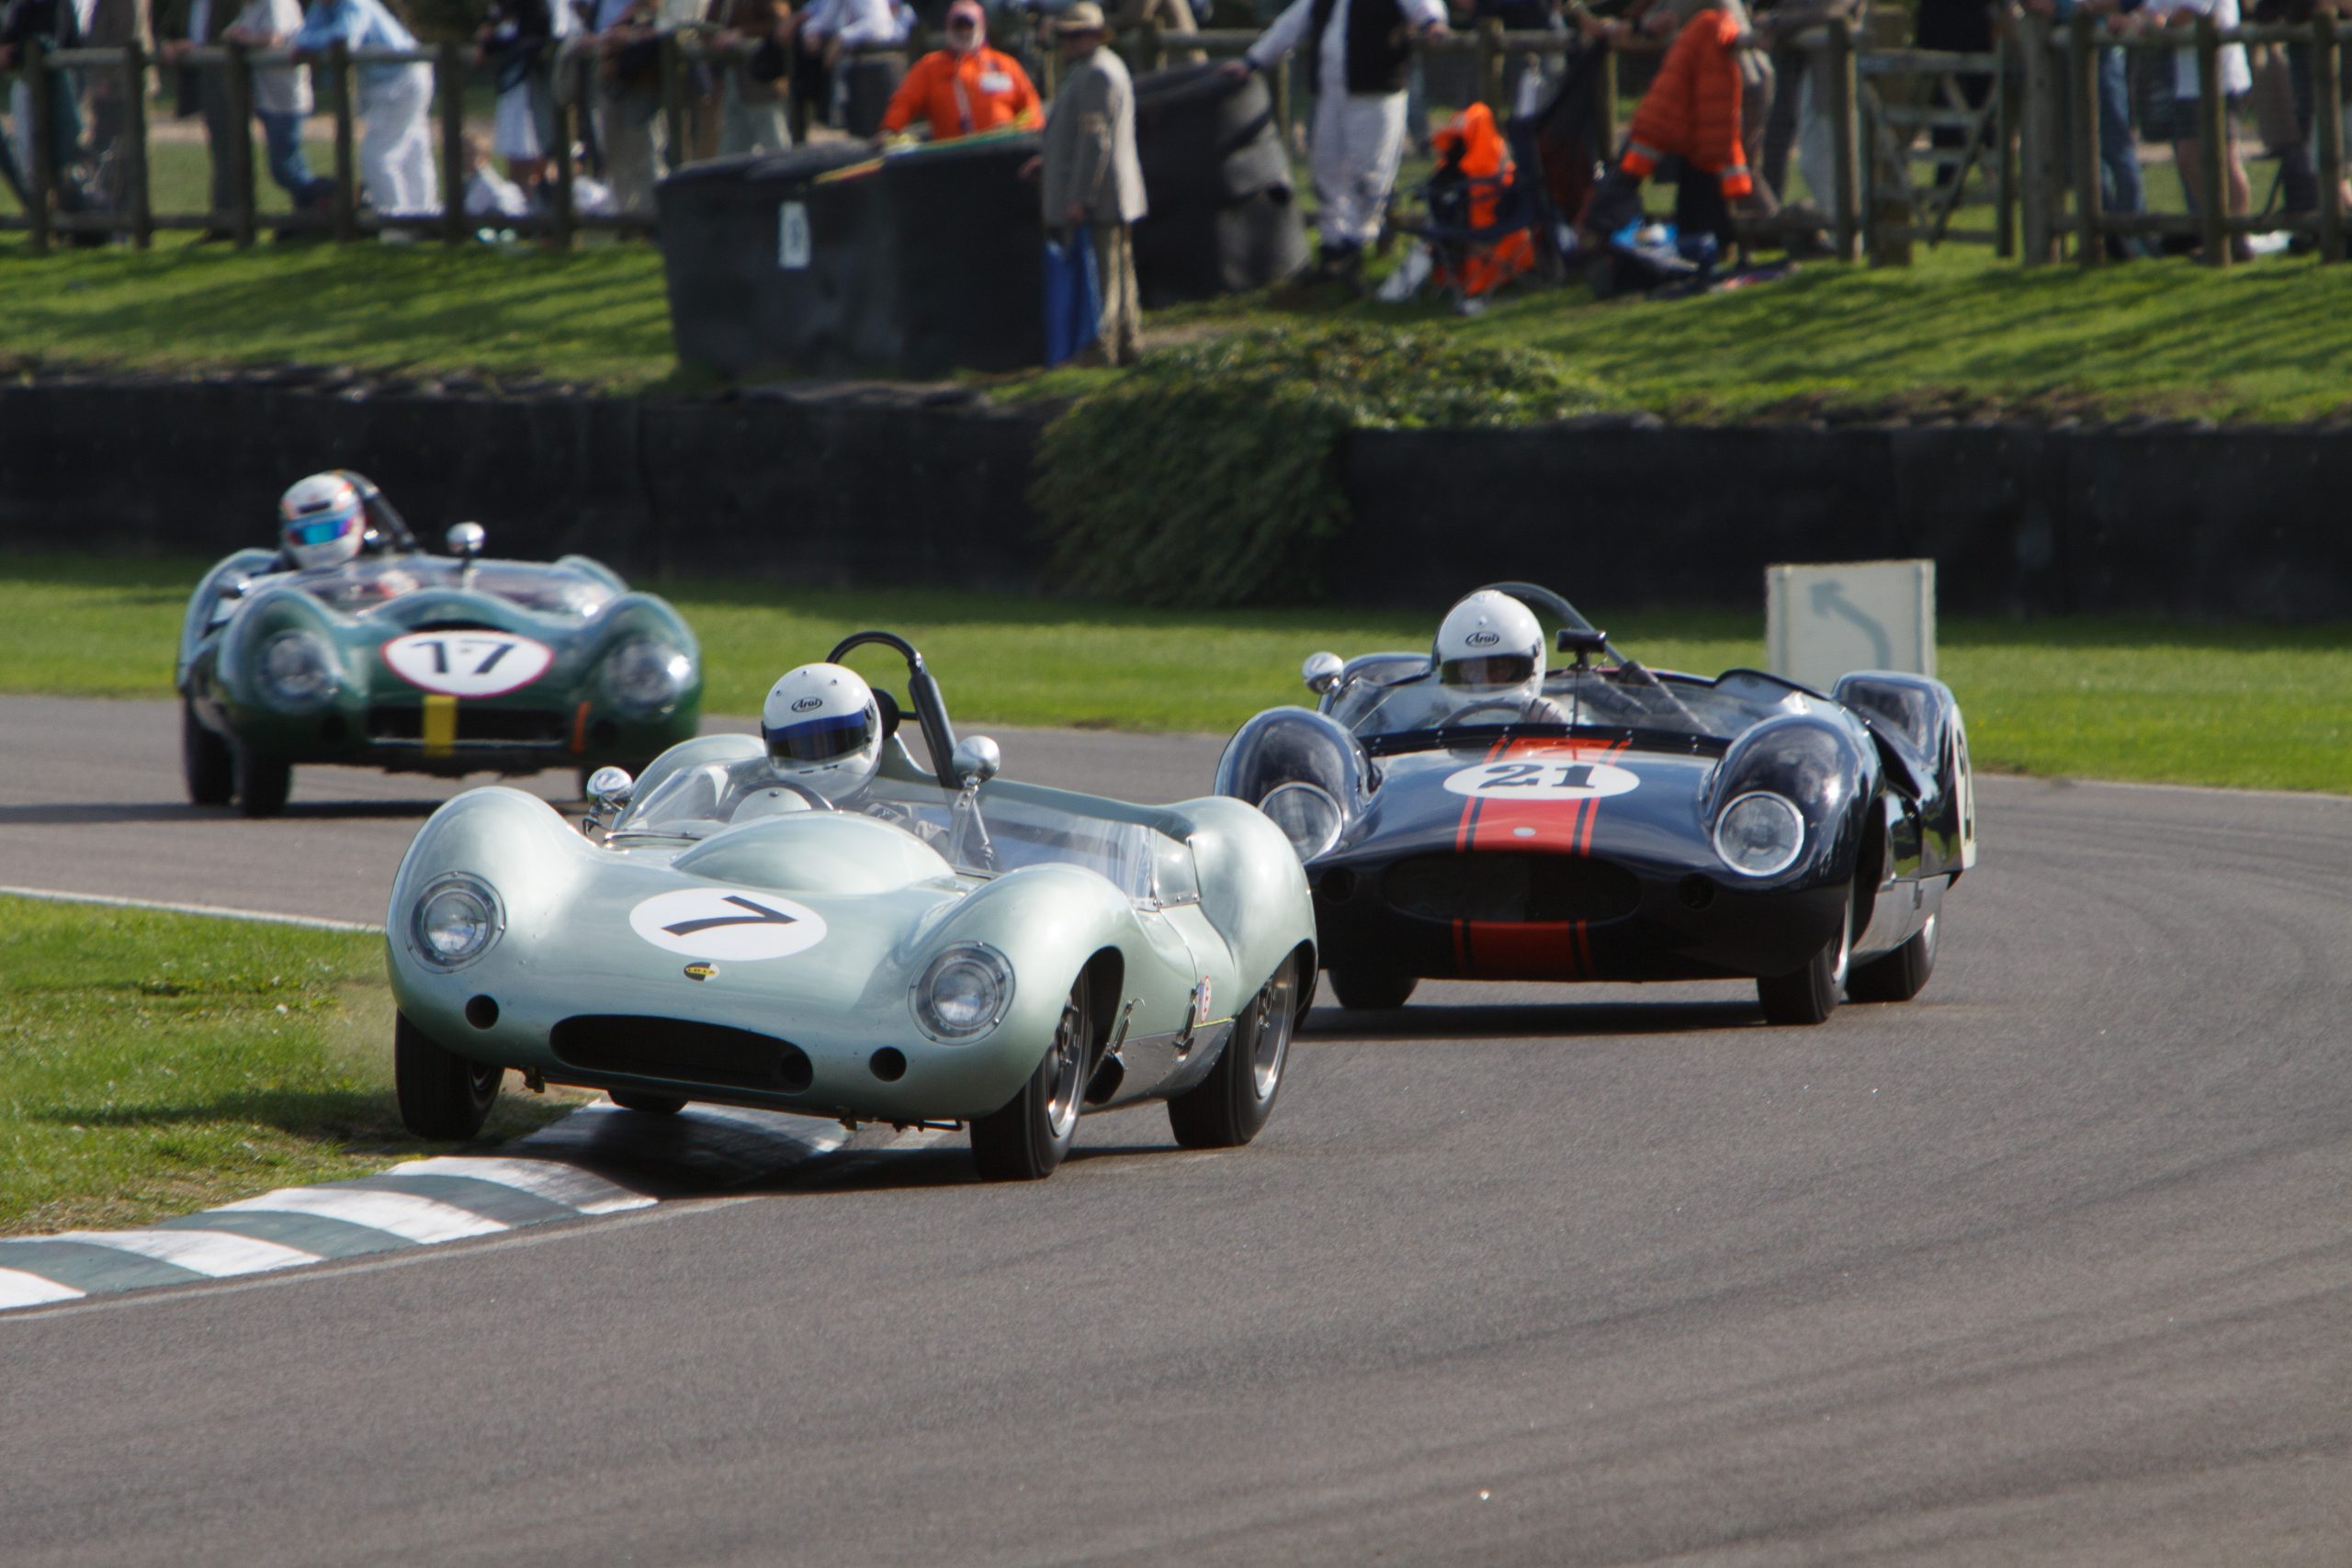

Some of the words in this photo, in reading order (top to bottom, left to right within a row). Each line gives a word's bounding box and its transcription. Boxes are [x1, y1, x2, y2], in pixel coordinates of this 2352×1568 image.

[412, 639, 516, 674] 17
[1477, 764, 1596, 789] 21
[661, 896, 798, 936] 7
